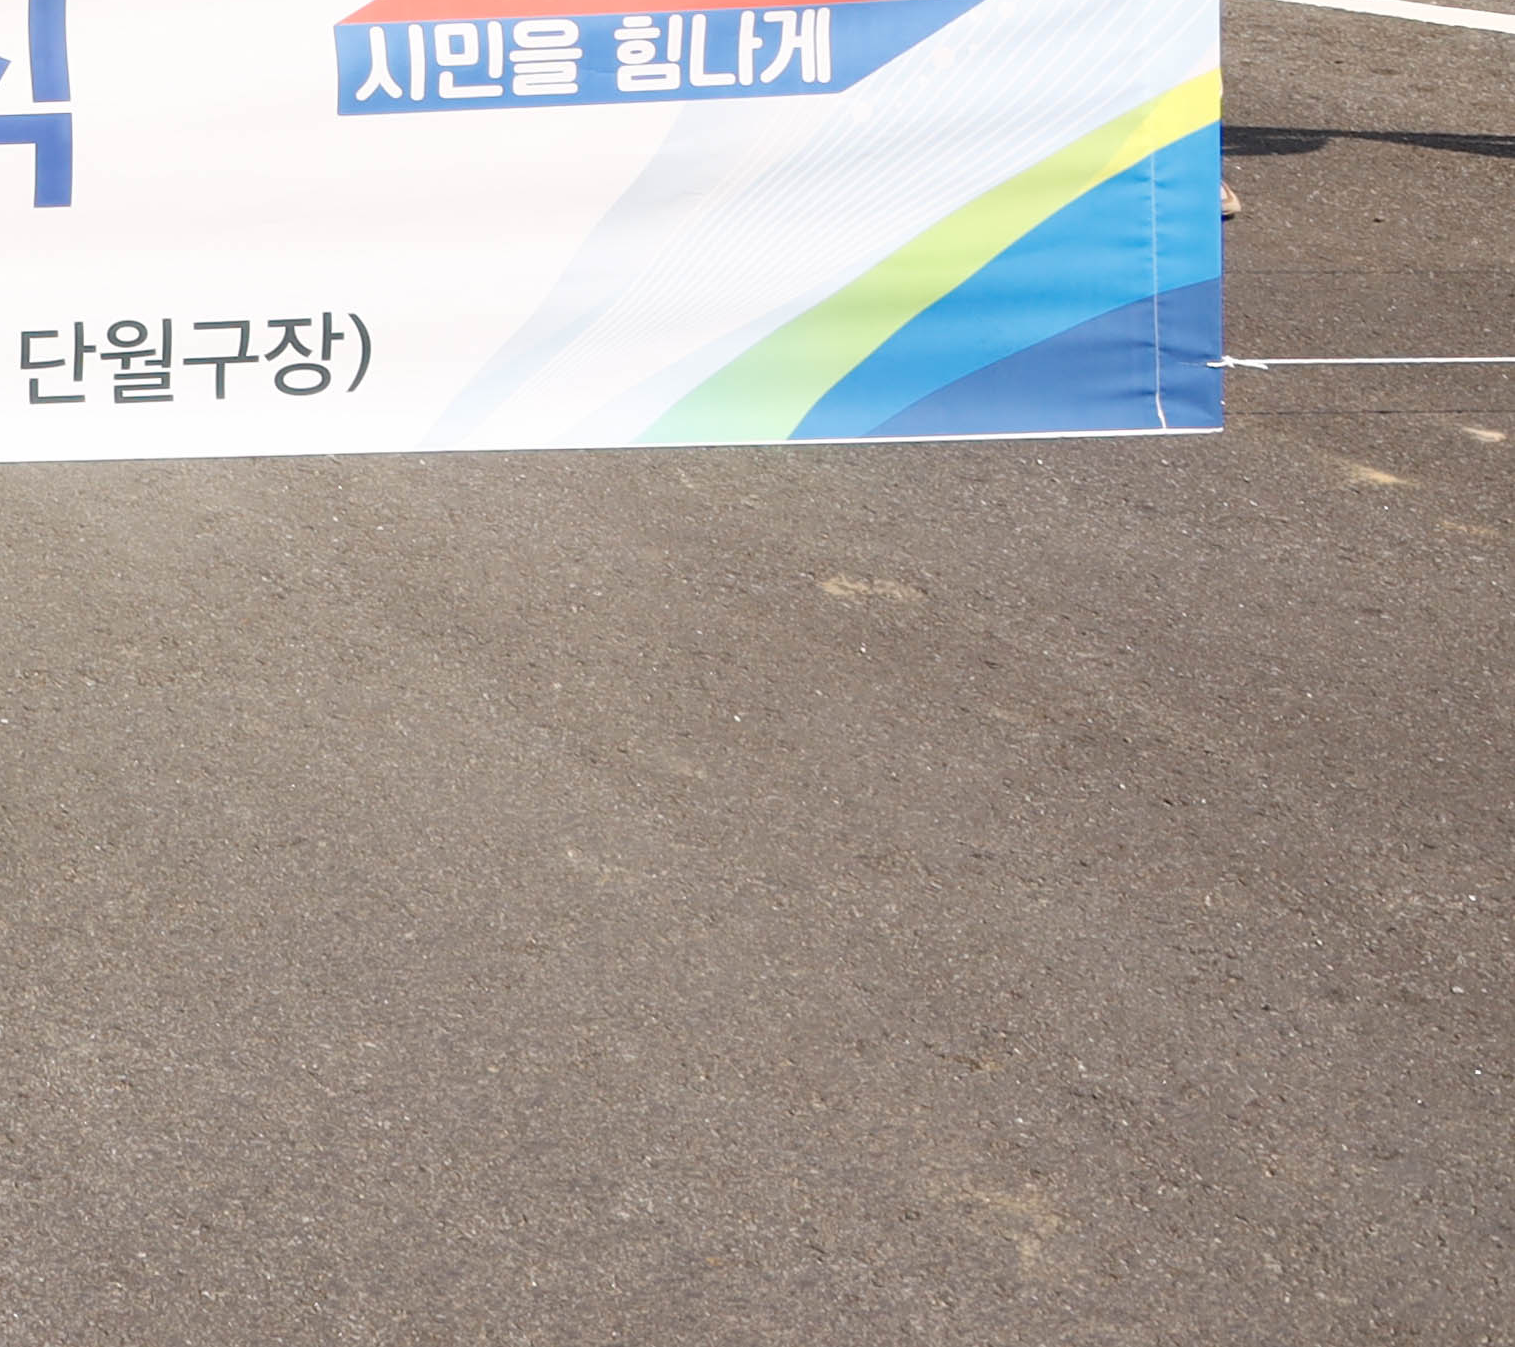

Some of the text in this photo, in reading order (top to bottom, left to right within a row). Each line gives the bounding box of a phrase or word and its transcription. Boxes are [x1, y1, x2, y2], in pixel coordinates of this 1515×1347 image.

[356, 7, 831, 101] 시민을 힘나게
[20, 312, 371, 404] 단월구장)
